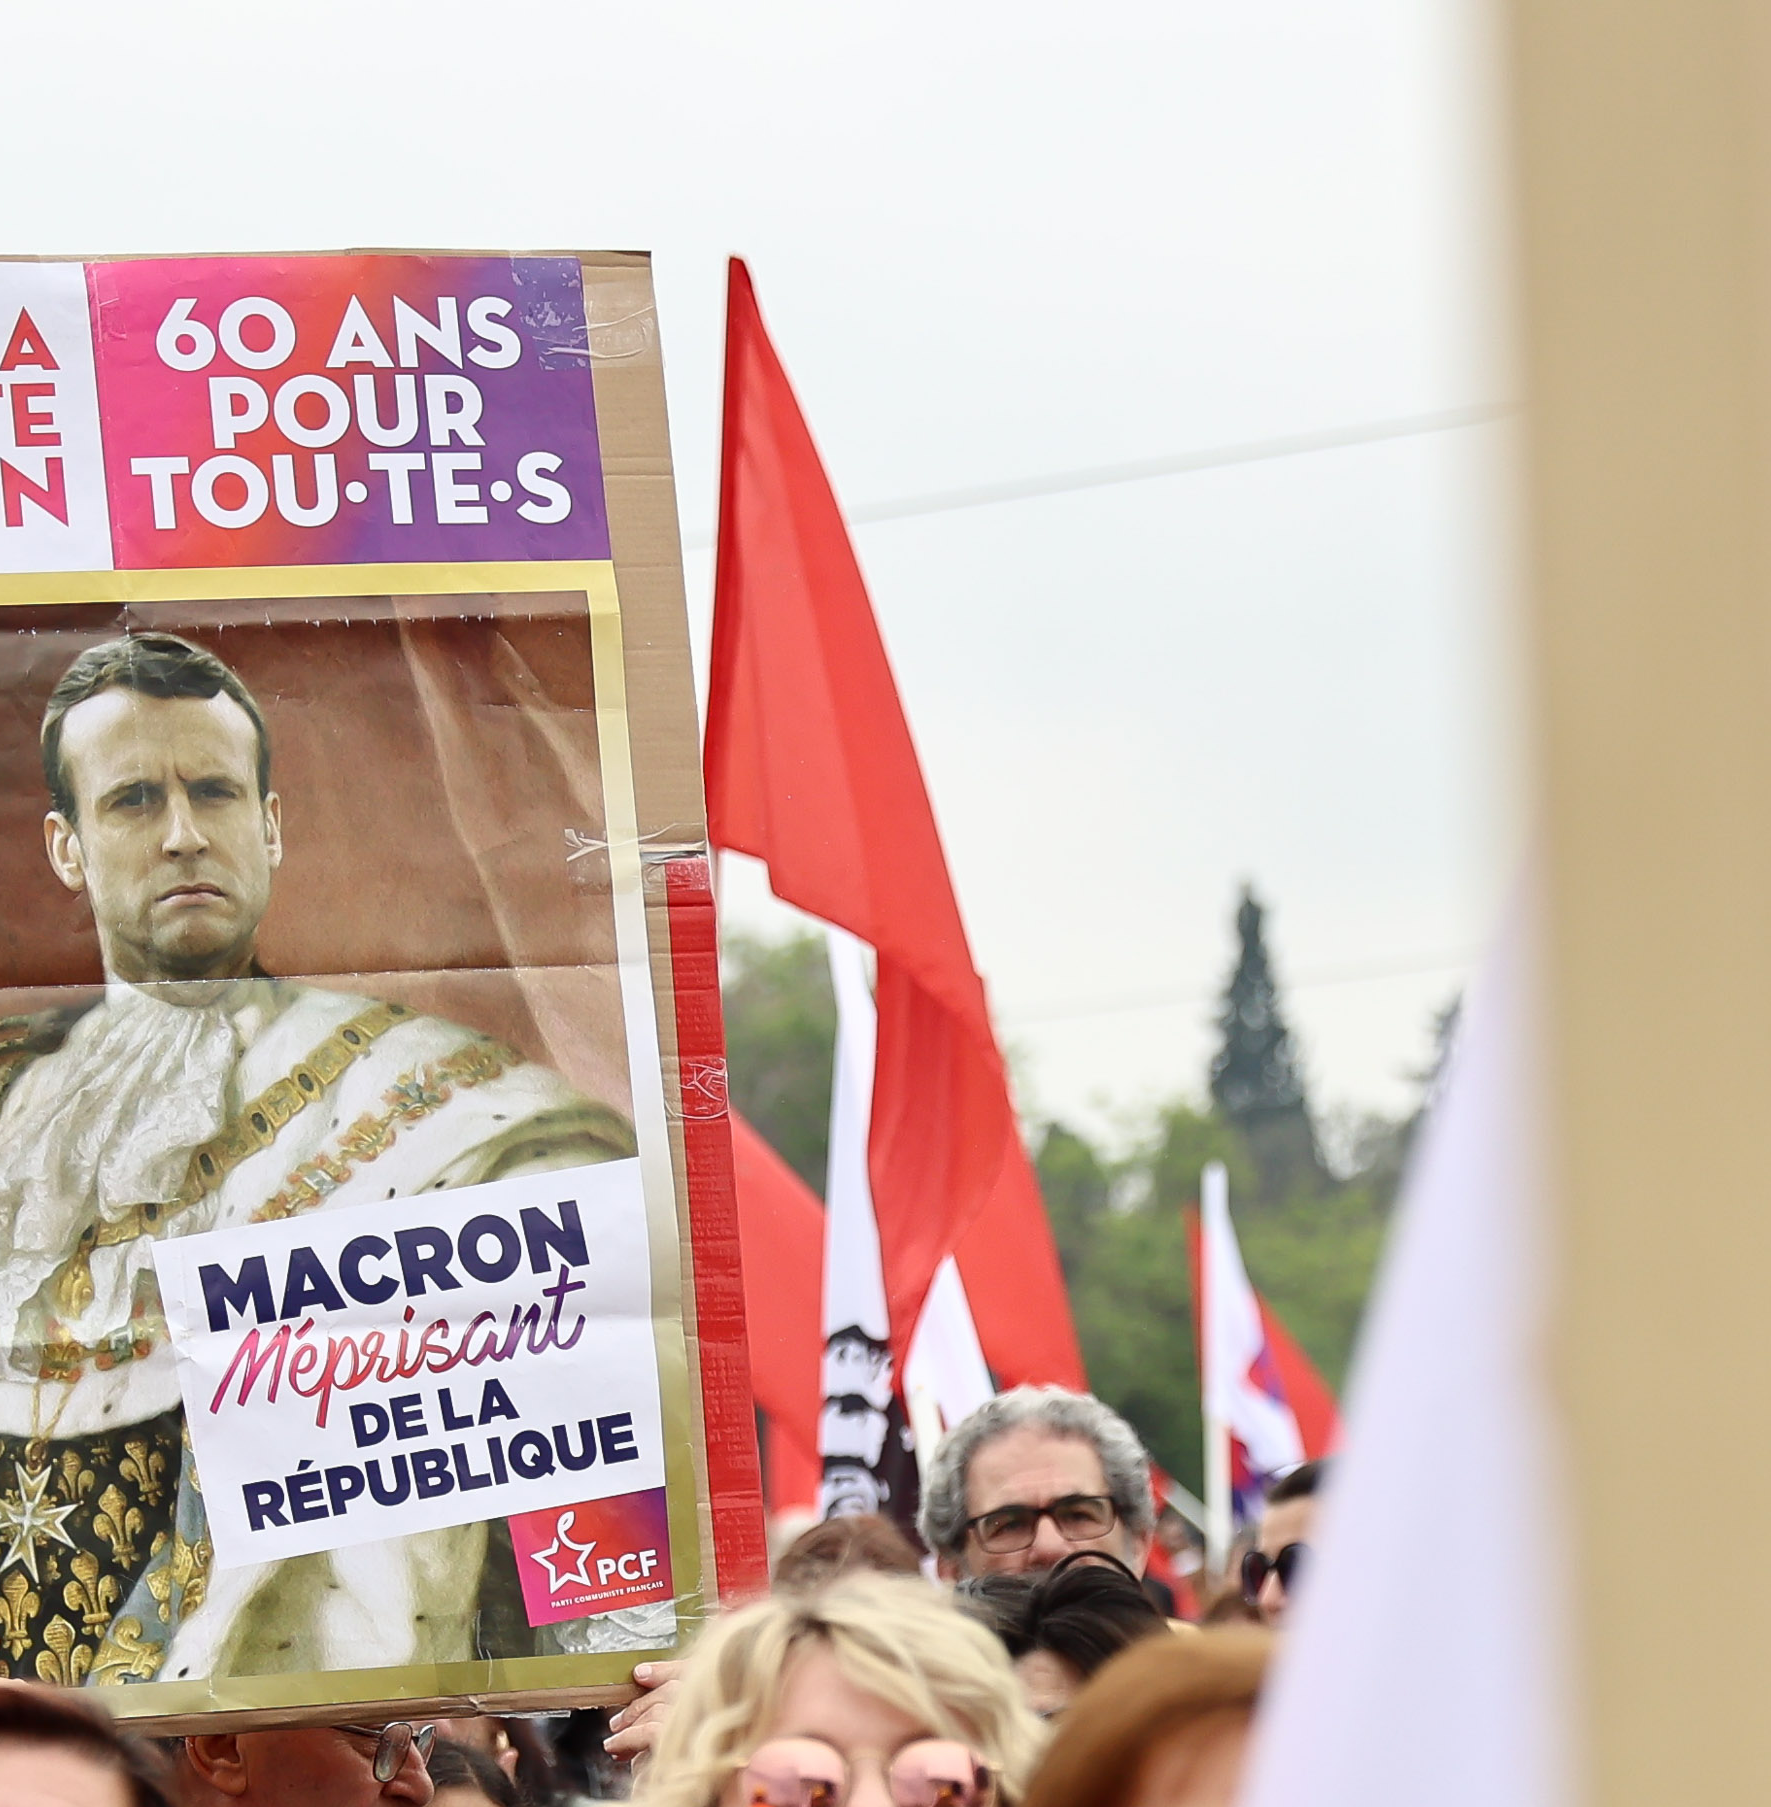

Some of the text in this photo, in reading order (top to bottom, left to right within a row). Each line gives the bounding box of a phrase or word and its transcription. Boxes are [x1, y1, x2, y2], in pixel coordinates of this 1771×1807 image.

[155, 294, 522, 372] 60 ANS
[208, 374, 486, 449] POUR
[198, 1200, 591, 1333] MACRON
[209, 1264, 587, 1429] Méprisant
[349, 1378, 521, 1449] DE LA
[241, 1411, 640, 1533] RÉPUBLIQUE
[550, 1580, 664, 1609] PARTI COMMUNISTE FRANÇAIS
[596, 1549, 658, 1586] PCF
